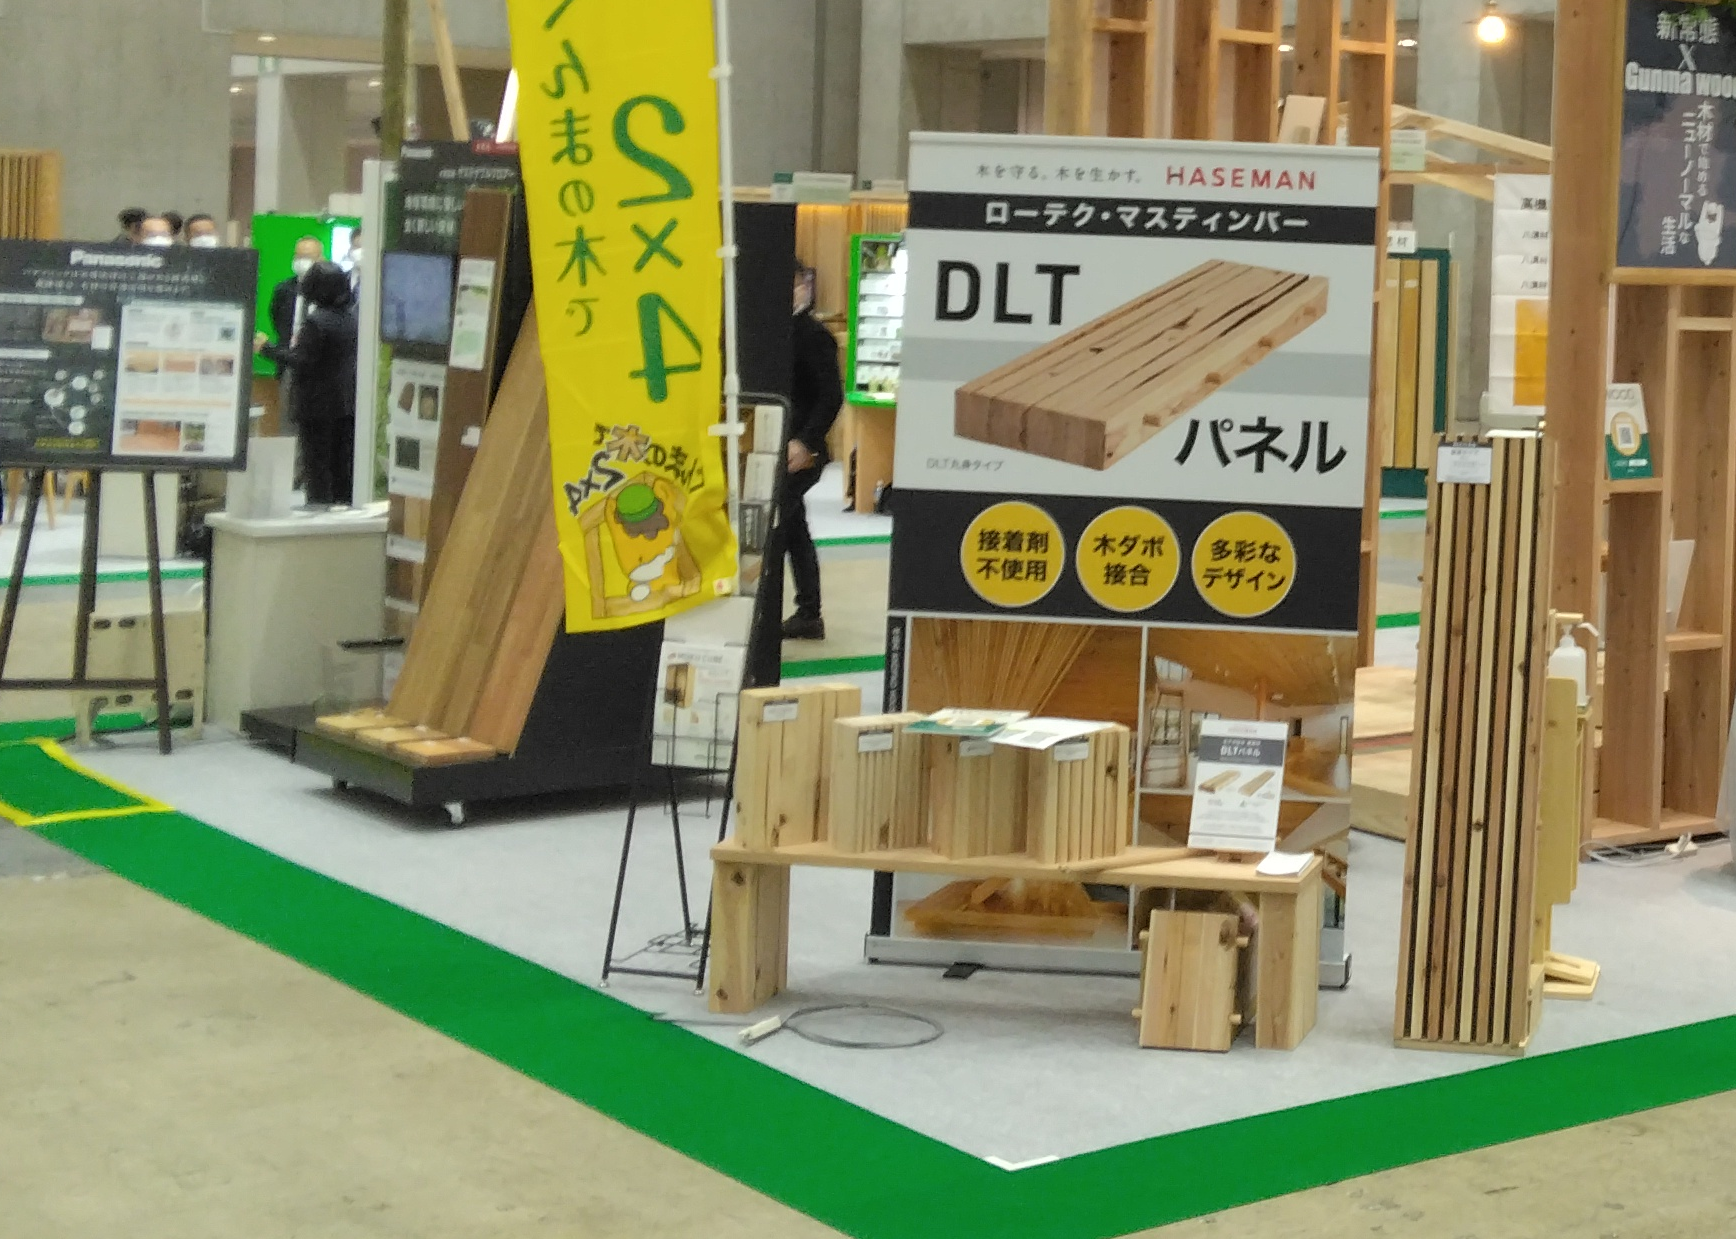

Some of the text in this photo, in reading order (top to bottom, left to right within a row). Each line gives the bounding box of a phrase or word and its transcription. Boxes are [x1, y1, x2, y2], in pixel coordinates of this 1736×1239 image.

[1624, 61, 1693, 95] Gunma
[1165, 166, 1317, 191] HASEMAN
[1677, 112, 1697, 245] ニューノーマルな
[985, 202, 1309, 234] ローテク・マスティンバー
[1660, 215, 1678, 256] 生活
[935, 260, 1081, 327] DLT
[1174, 417, 1347, 474] パネル
[977, 529, 1049, 555] 接着剤
[1093, 534, 1166, 558] 木ダボ
[1209, 539, 1282, 564] 多彩な
[976, 557, 1048, 583] 不使用
[1102, 563, 1151, 588] 接合
[1202, 566, 1287, 593] デザイン
